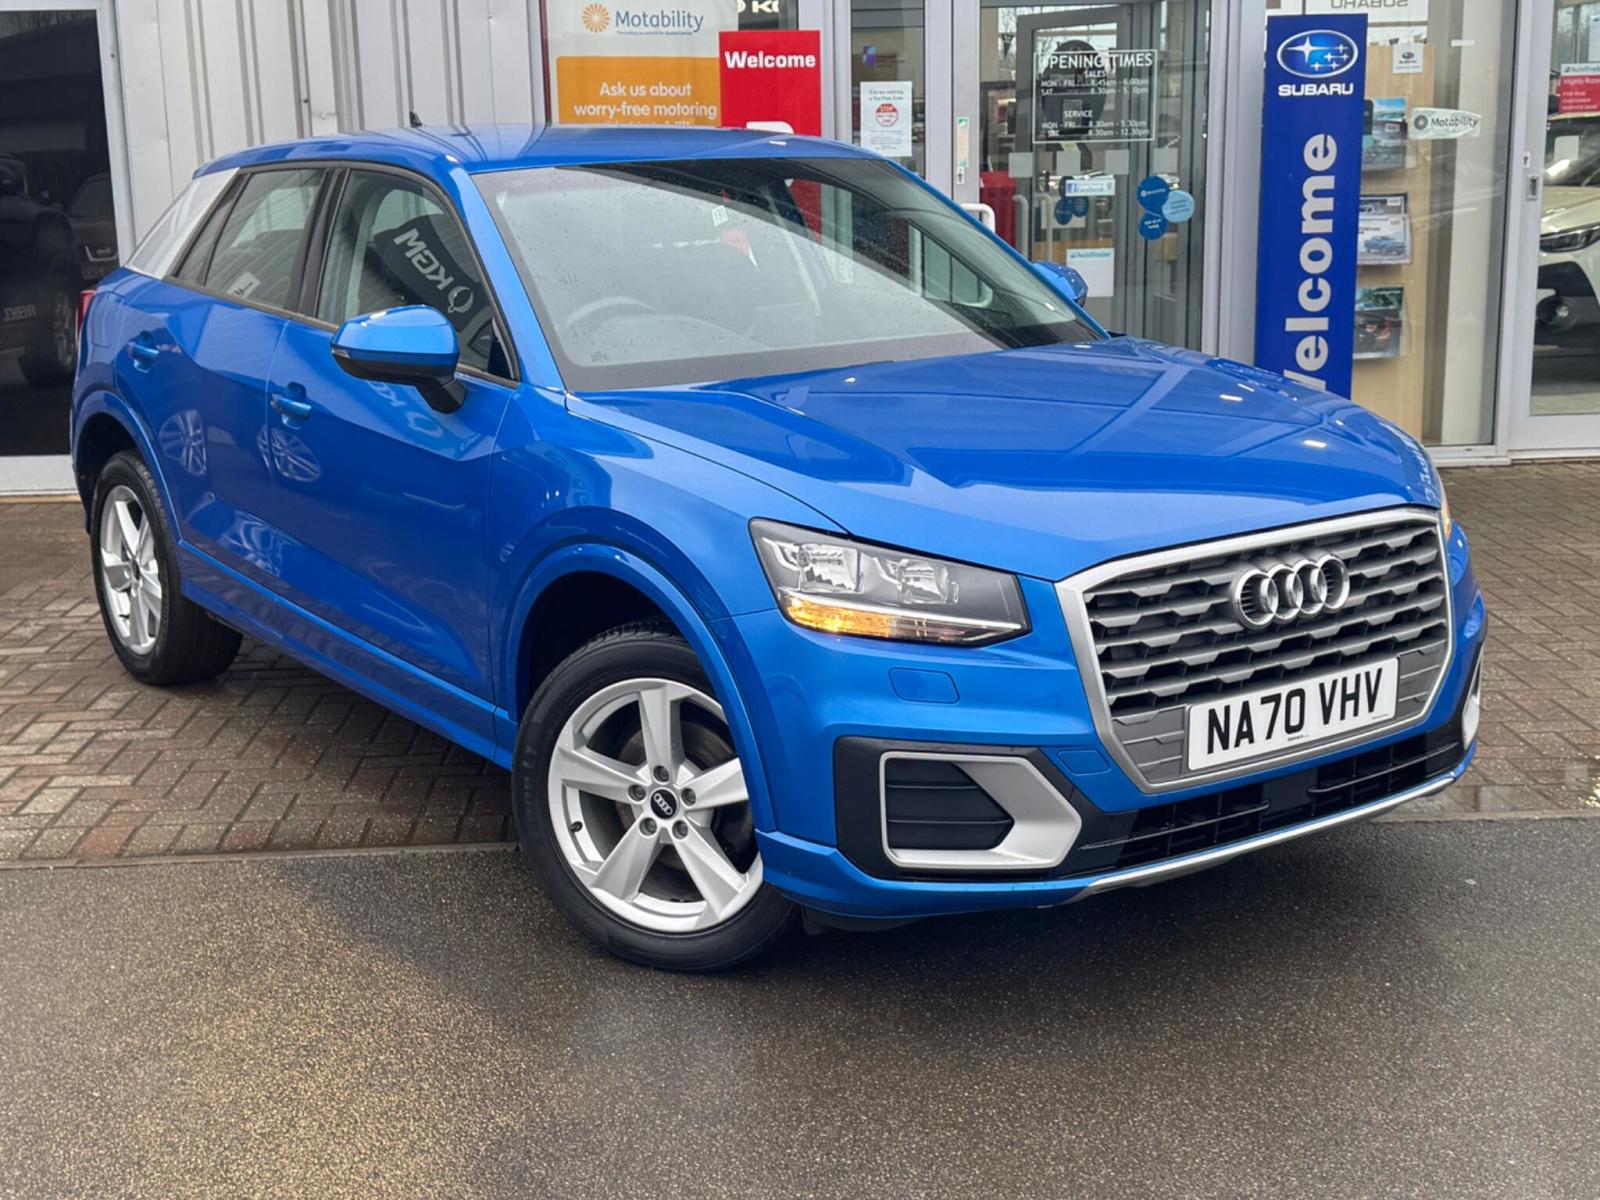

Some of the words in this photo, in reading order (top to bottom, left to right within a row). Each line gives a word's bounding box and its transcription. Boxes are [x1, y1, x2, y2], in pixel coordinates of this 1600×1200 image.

[615, 10, 704, 33] Motability
[724, 50, 816, 69] Welcome
[1109, 53, 1153, 68] TIMES
[599, 81, 626, 97] Ask
[629, 84, 646, 97] us
[650, 82, 692, 97] about
[1278, 83, 1354, 96] SUBARU
[574, 101, 650, 119] worry-free
[654, 102, 717, 120] motoring
[1063, 110, 1093, 118] SERVICE
[1430, 116, 1479, 129] Motability
[1207, 687, 1306, 754] NA70
[1318, 667, 1383, 725] VHV
